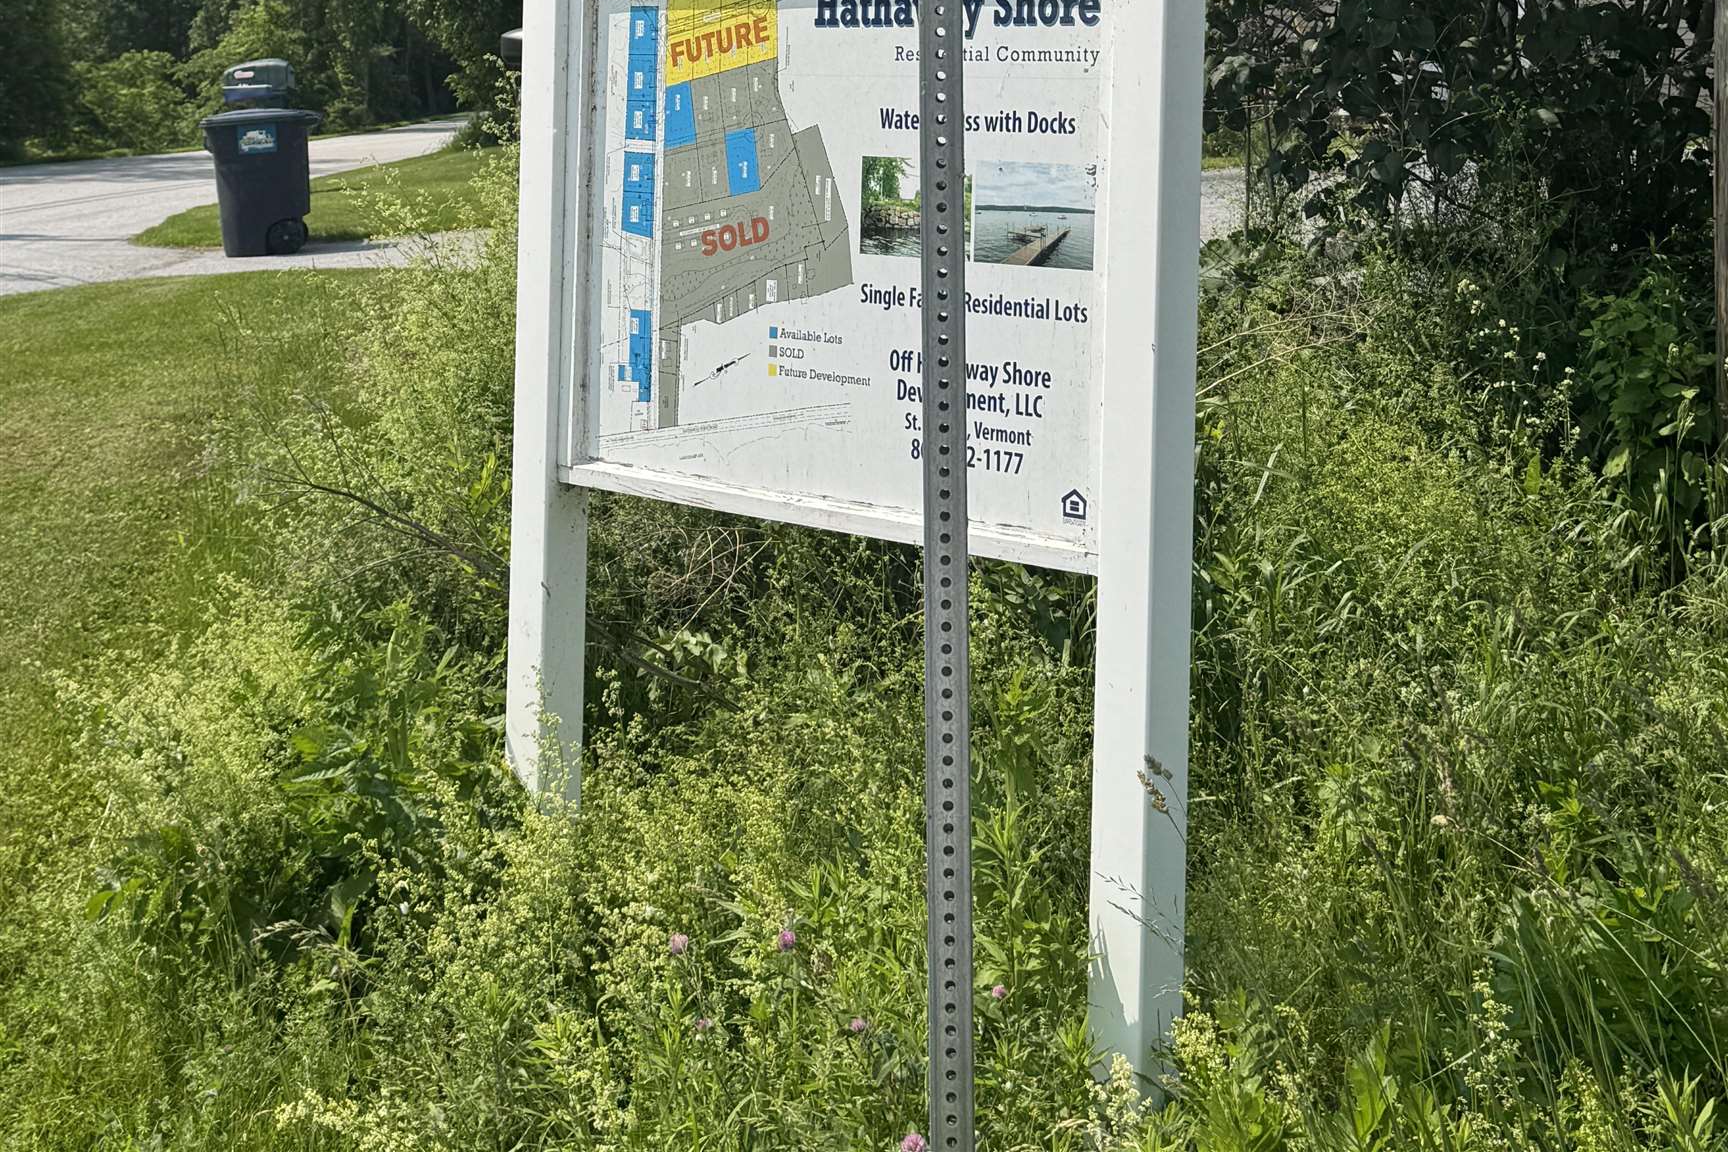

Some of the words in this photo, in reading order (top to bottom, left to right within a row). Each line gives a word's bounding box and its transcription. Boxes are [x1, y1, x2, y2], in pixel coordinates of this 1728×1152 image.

[669, 16, 770, 67] FUTURE
[895, 46, 989, 62] Restial
[996, 46, 1100, 66] Community
[880, 107, 921, 130] Wate
[984, 110, 1022, 133] with
[1027, 111, 1076, 135] Docks
[701, 216, 770, 257] SOLD
[860, 283, 905, 311] Single
[965, 291, 1050, 320] Residential
[1054, 298, 1088, 323] Lots
[780, 328, 821, 342] Available
[823, 333, 843, 345] Lots
[779, 347, 804, 359] SOLD
[779, 365, 807, 379] Future
[809, 369, 871, 386] Development
[890, 349, 913, 373] Off
[1002, 361, 1051, 389] Shore
[1014, 393, 1043, 418] LLC
[905, 412, 921, 431] St.
[974, 421, 1032, 447] Vermont
[911, 438, 1023, 475] 82-1177
